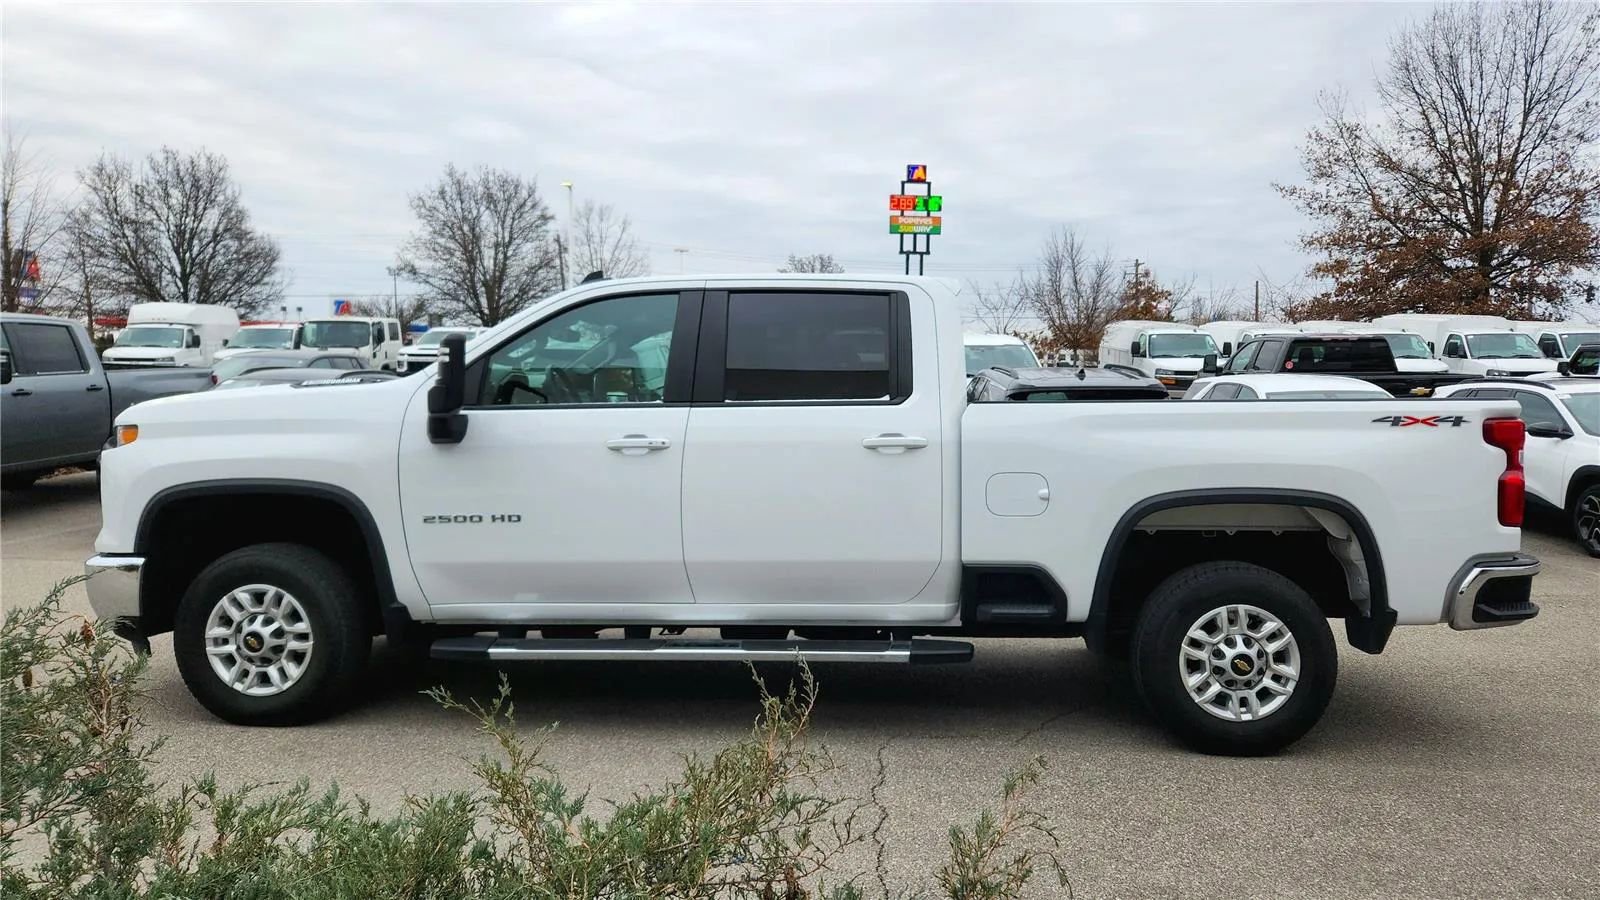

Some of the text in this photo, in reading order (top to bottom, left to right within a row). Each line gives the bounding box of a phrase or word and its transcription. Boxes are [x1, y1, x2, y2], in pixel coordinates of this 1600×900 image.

[908, 165, 926, 180] TA
[898, 225, 933, 233] SUBWAY
[334, 299, 352, 316] TA
[423, 514, 522, 524] 2500 HD
